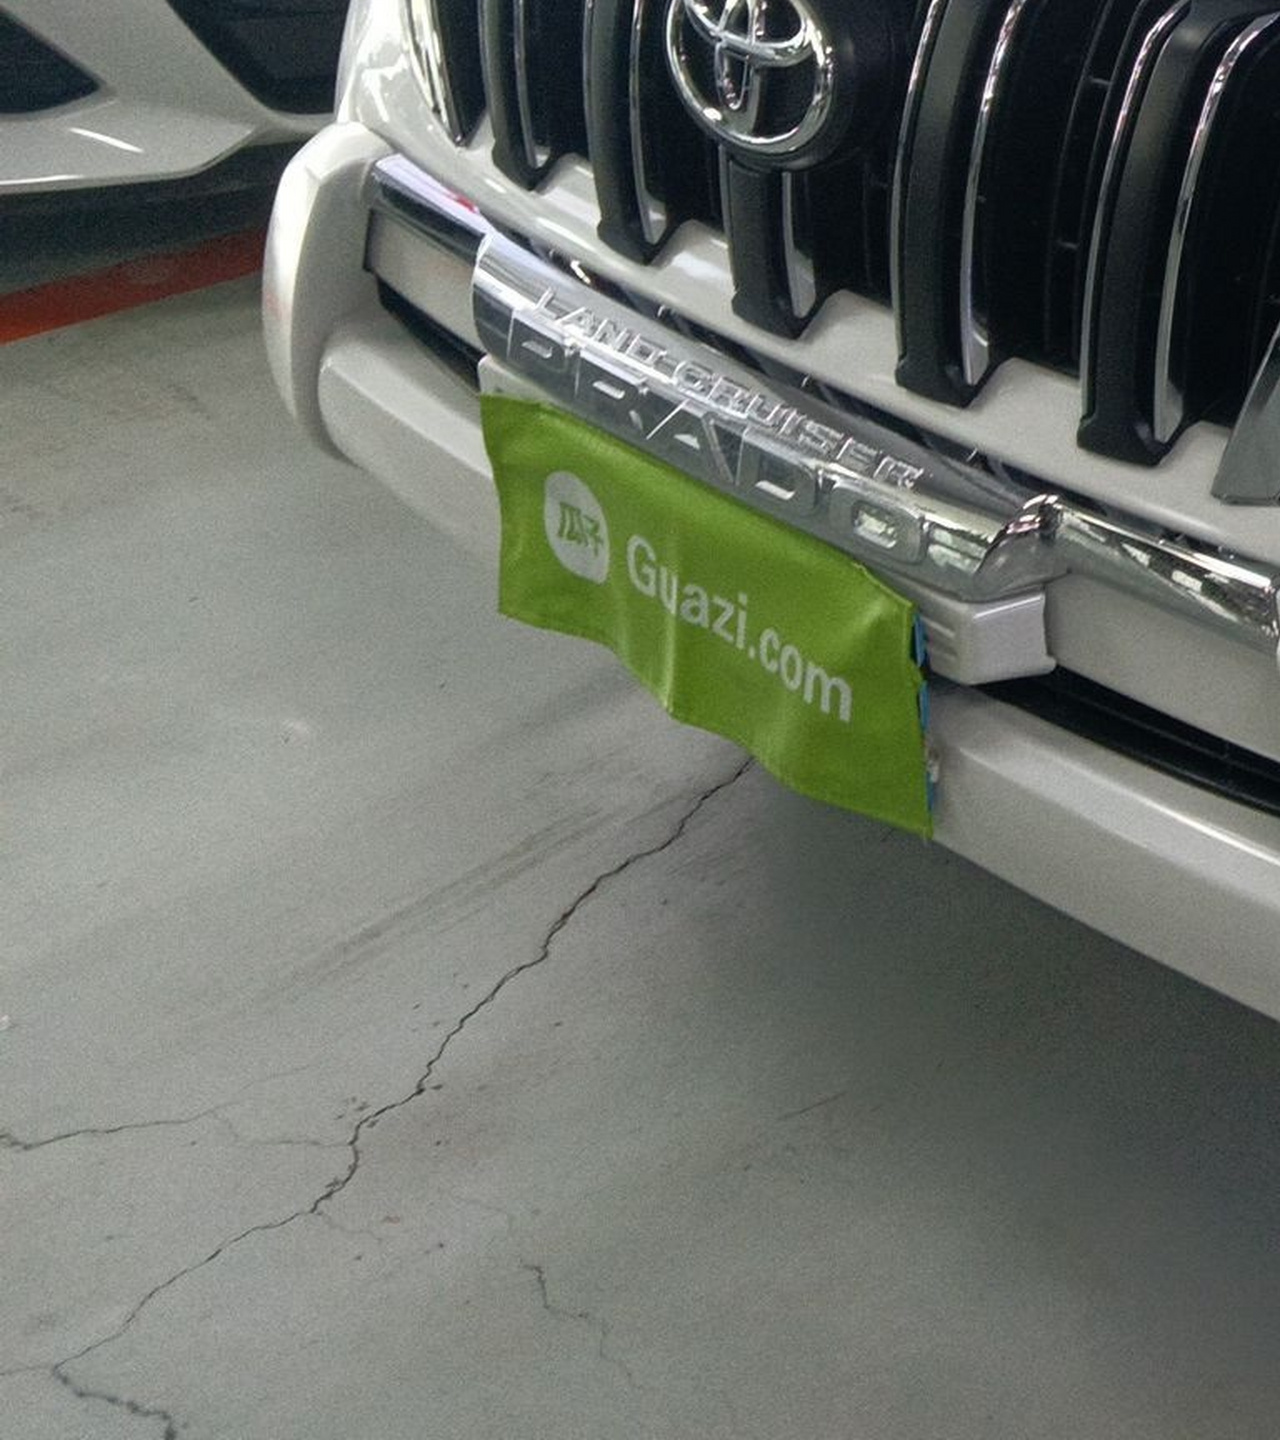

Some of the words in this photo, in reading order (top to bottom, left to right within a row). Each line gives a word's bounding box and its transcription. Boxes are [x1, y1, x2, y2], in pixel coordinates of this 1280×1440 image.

[531, 287, 668, 364] LAND
[672, 359, 926, 489] CRUISER
[627, 535, 853, 723] Guazi.com
